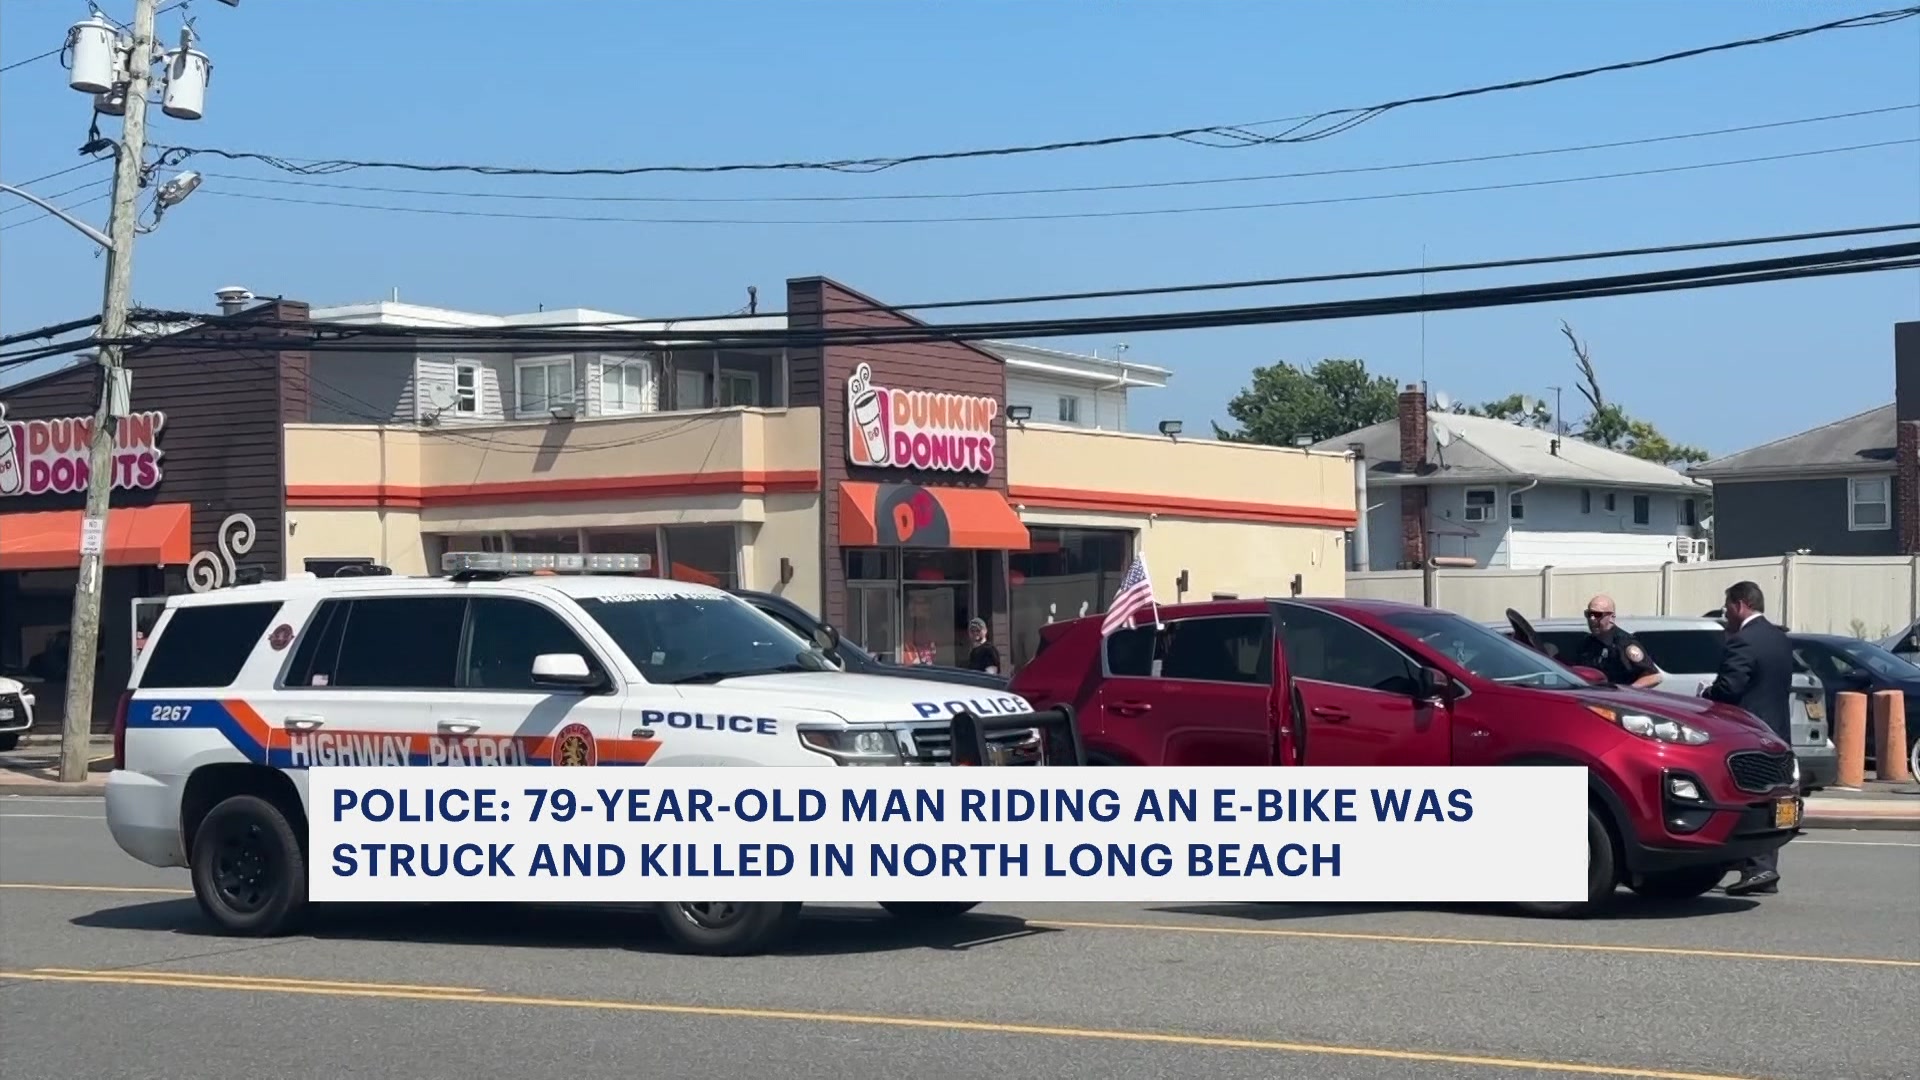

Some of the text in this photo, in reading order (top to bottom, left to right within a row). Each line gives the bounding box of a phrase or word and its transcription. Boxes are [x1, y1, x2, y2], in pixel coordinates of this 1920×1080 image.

[894, 392, 996, 432] DUNKIN'
[29, 413, 161, 455] DUNIN'
[894, 431, 992, 471] DONUTS
[151, 705, 192, 721] 2267
[641, 710, 778, 735] POLICE
[912, 696, 1029, 718] POLICE
[290, 732, 528, 767] HIGHWAY PATROL
